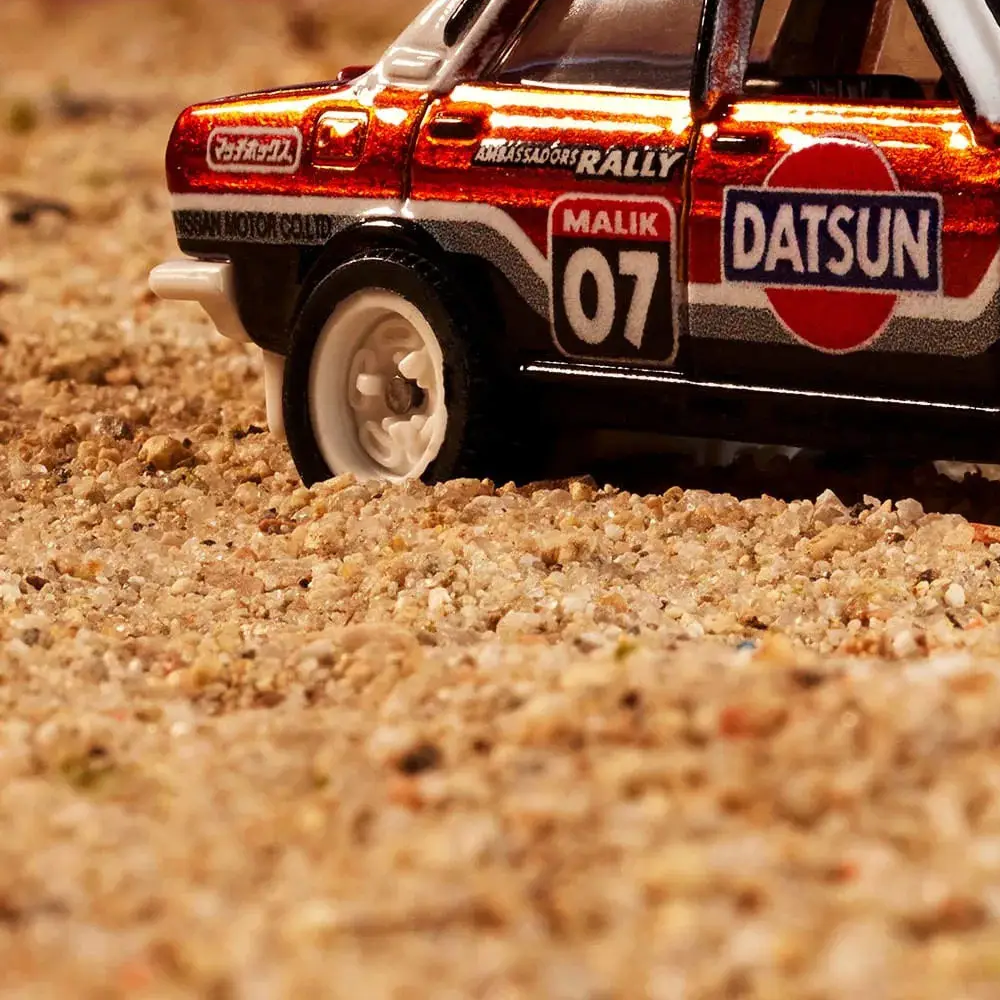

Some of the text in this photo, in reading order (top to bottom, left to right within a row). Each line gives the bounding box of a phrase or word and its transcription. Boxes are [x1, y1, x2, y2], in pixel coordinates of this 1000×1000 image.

[475, 143, 684, 178] AMBASSADORS RALLY
[224, 212, 276, 238] MOTOR
[563, 209, 659, 236] MALIK
[733, 202, 930, 279] DATSUN
[562, 247, 659, 349] 07
